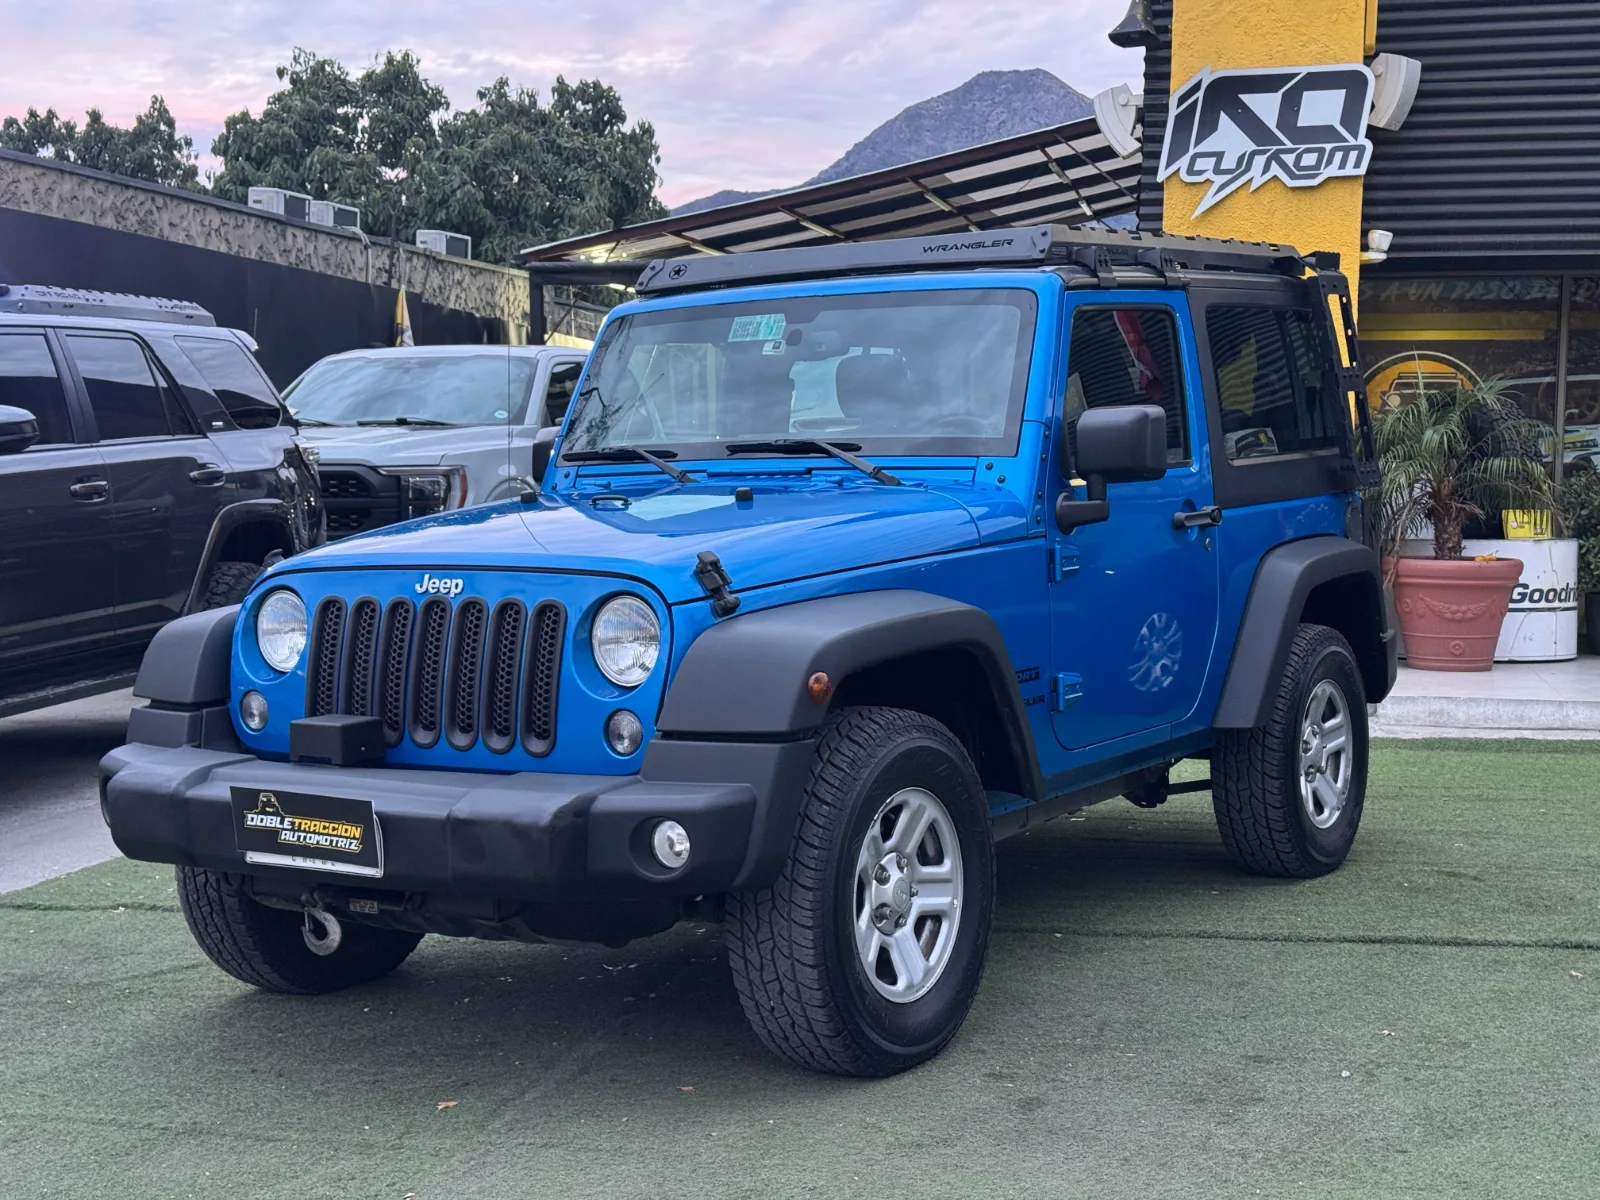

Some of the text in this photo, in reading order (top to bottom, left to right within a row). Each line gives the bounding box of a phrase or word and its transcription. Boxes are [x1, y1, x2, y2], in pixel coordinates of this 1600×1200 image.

[922, 238, 1015, 253] WRANGLER
[1450, 281, 1519, 301] PASO
[414, 573, 464, 598] Jeep
[280, 830, 360, 850] AUTOMOTRIZ
